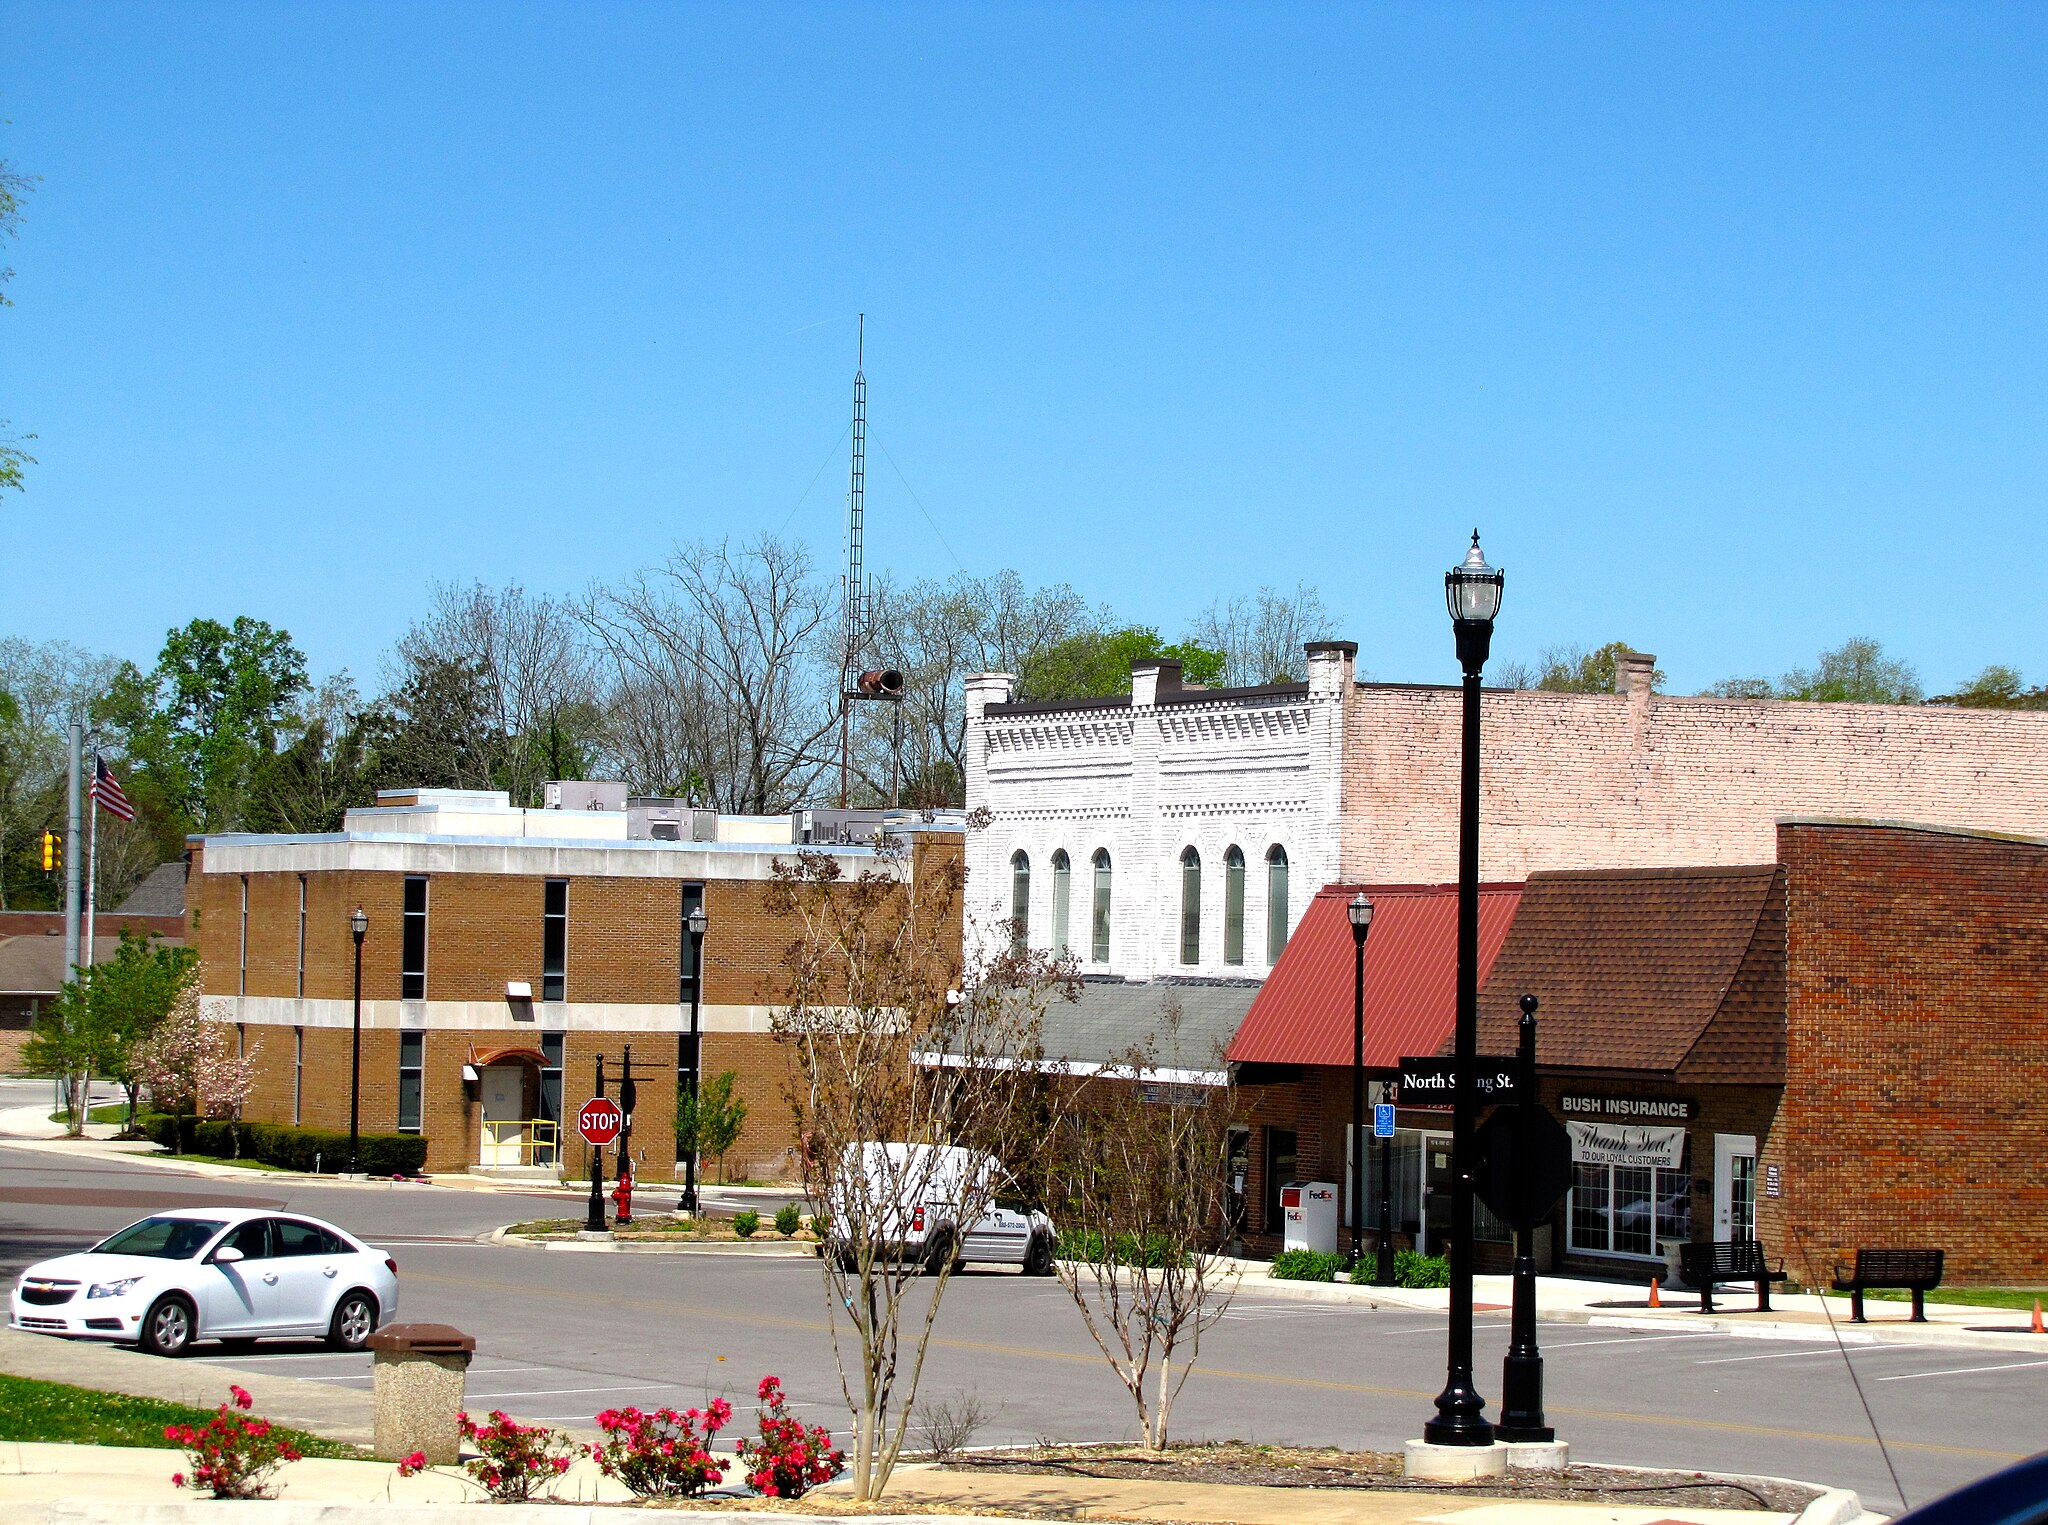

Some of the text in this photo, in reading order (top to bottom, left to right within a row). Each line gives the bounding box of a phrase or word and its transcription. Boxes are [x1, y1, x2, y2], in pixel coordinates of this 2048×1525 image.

[1403, 1073, 1445, 1089] North
[1496, 1073, 1514, 1088] St.
[1562, 1097, 1688, 1118] BUSH INSURANCE
[581, 1112, 619, 1130] STOP
[1578, 1125, 1675, 1154] Thank You!
[1581, 1151, 1671, 1167] TO OUR LOYAL CUSTOMERS
[1309, 1190, 1333, 1200] FedEx
